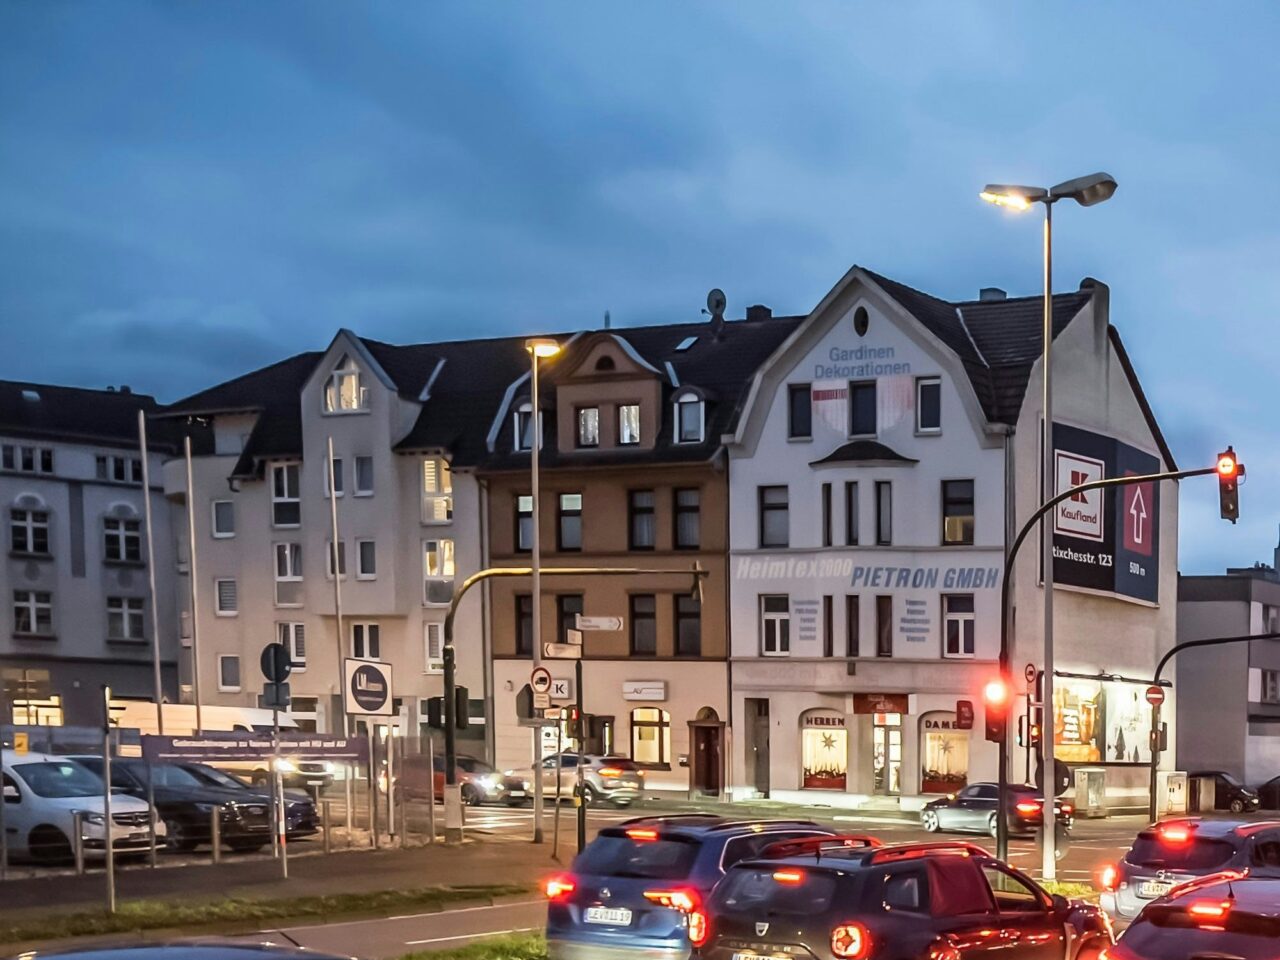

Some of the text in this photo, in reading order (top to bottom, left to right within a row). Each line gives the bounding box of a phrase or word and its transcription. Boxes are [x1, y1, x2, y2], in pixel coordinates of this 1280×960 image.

[829, 345, 896, 362] Gardinen
[814, 362, 912, 379] Dekorationen
[1061, 506, 1098, 525] Kaufland
[1052, 545, 1113, 567] tixchesstr. 123
[1129, 561, 1140, 575] 500
[850, 566, 1000, 589] PIETRON GMBH
[925, 719, 958, 729] DAME
